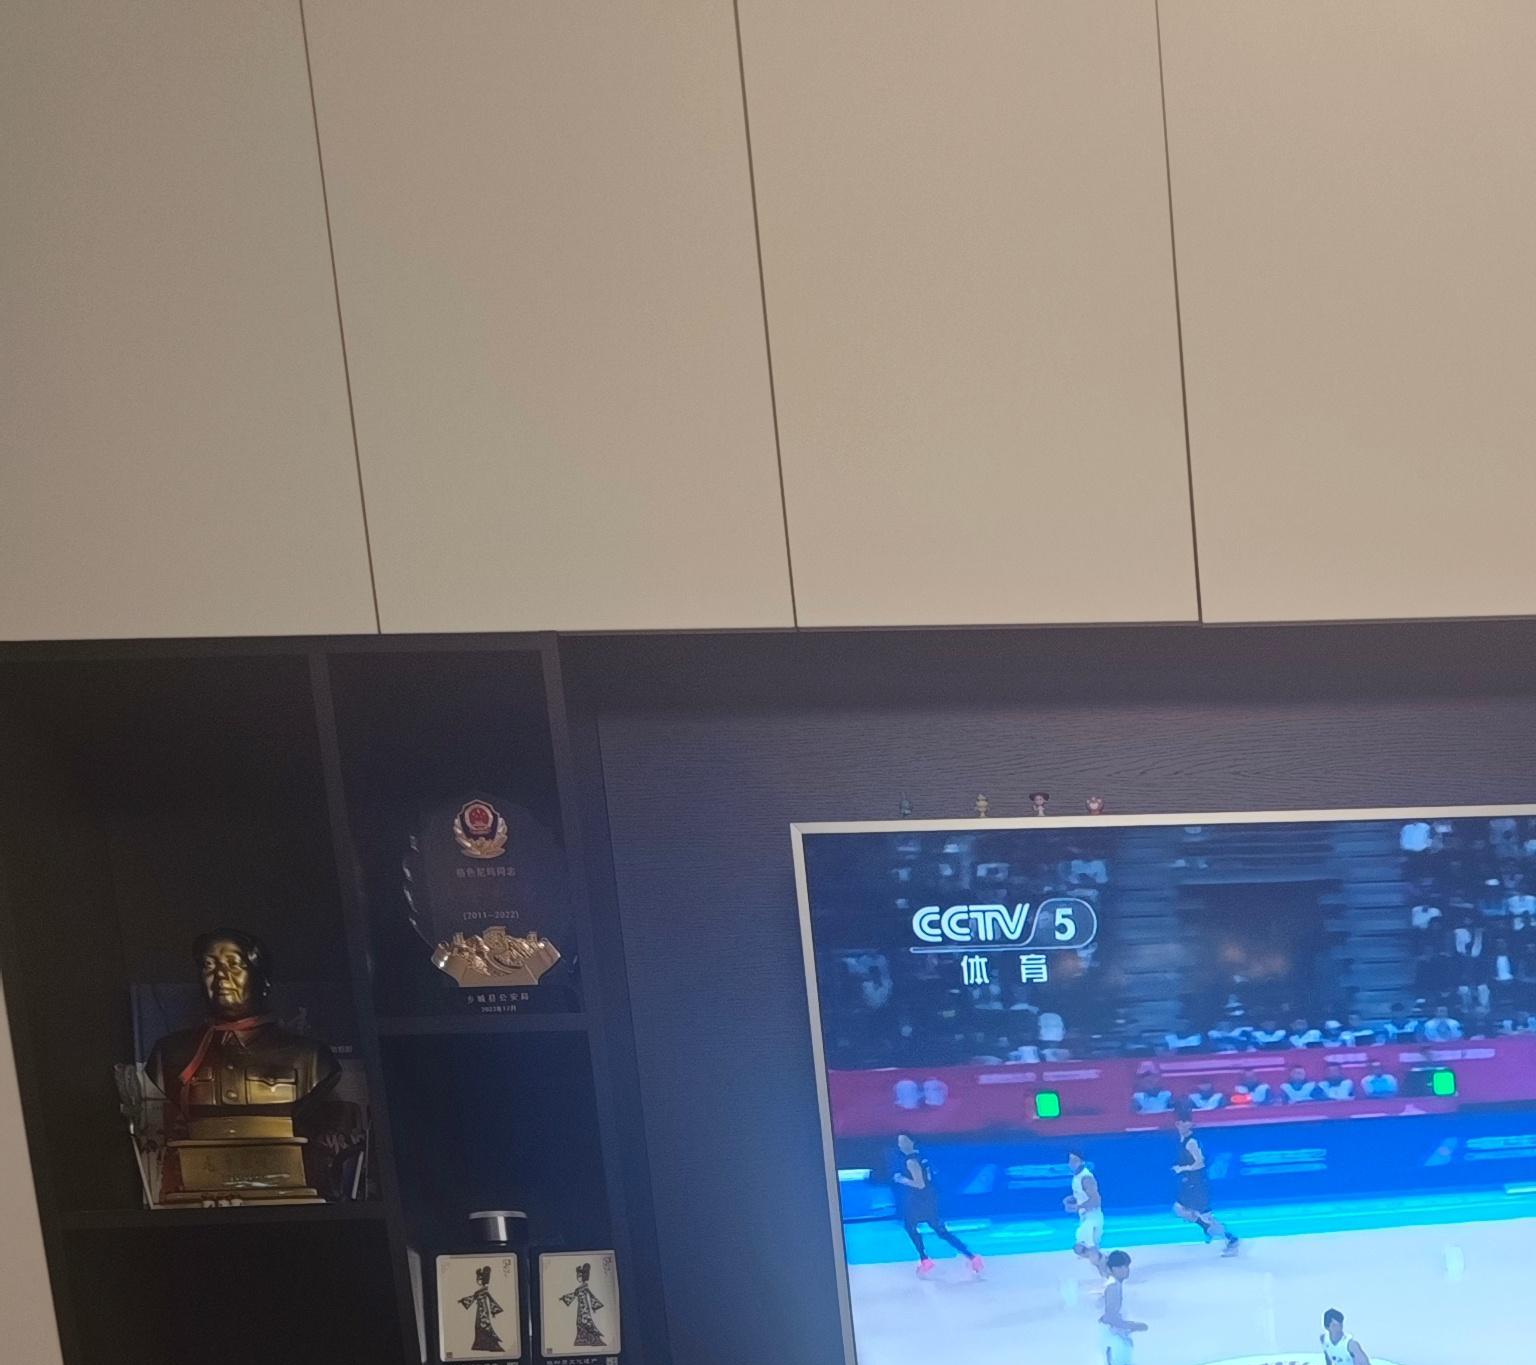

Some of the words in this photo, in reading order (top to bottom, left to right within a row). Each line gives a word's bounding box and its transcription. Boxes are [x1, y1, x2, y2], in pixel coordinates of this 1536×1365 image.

[912, 902, 1030, 942] CCTV
[1053, 907, 1076, 942] 5
[961, 953, 1048, 985] 体育
